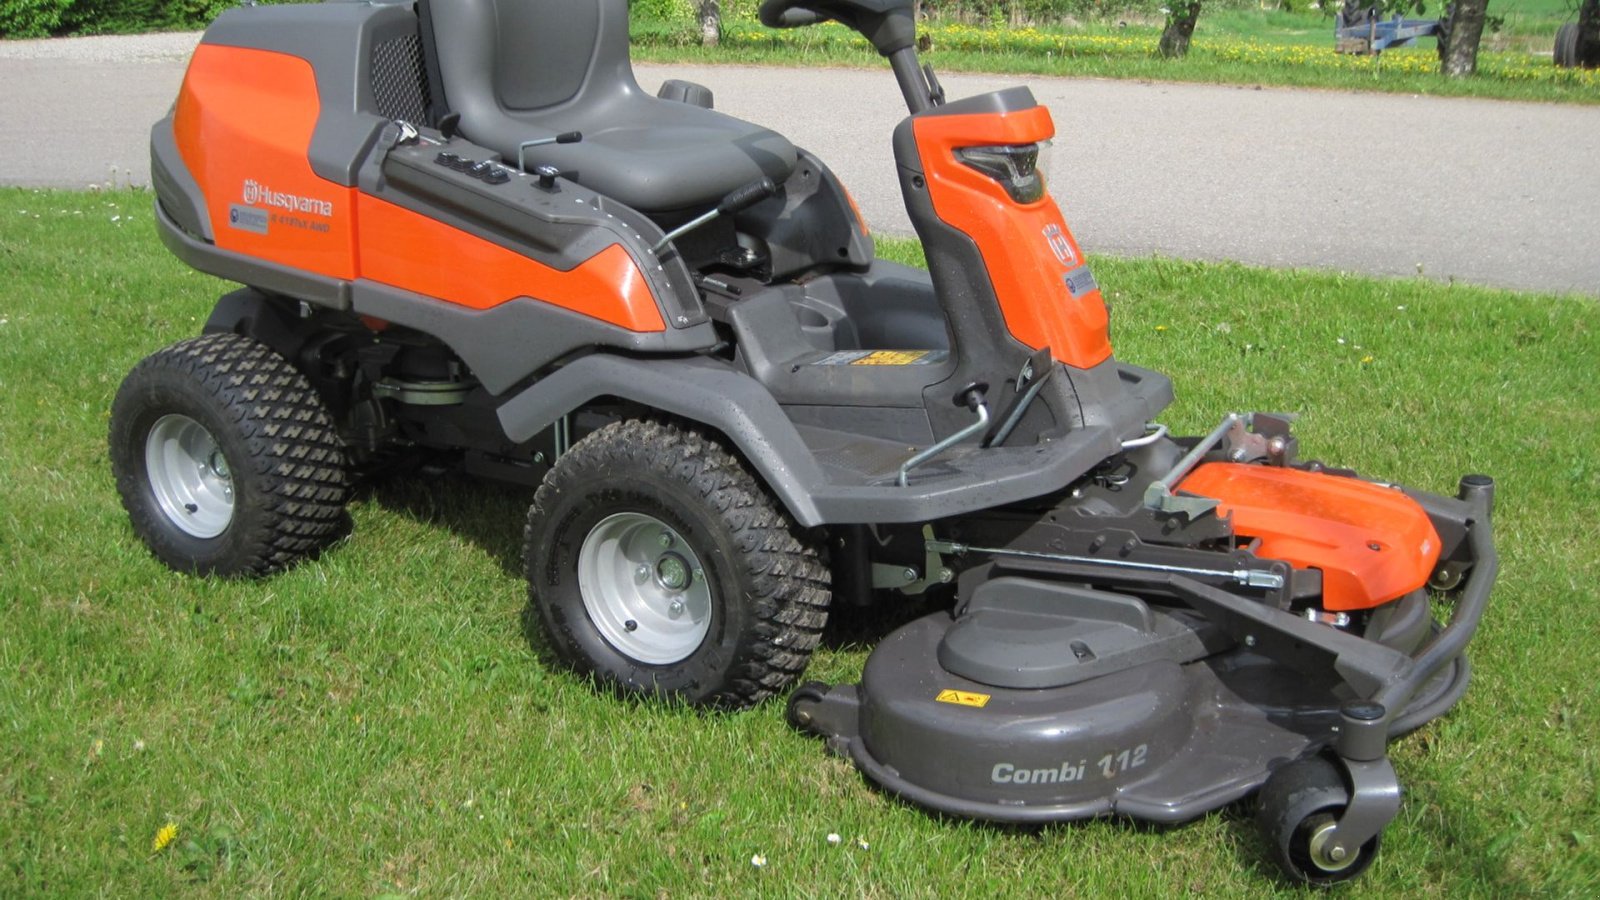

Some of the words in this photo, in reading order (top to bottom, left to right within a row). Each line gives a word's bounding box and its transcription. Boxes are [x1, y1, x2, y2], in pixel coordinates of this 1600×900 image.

[259, 184, 332, 216] Husqvarna
[991, 759, 1087, 784] Combi
[1097, 743, 1148, 780] 112
